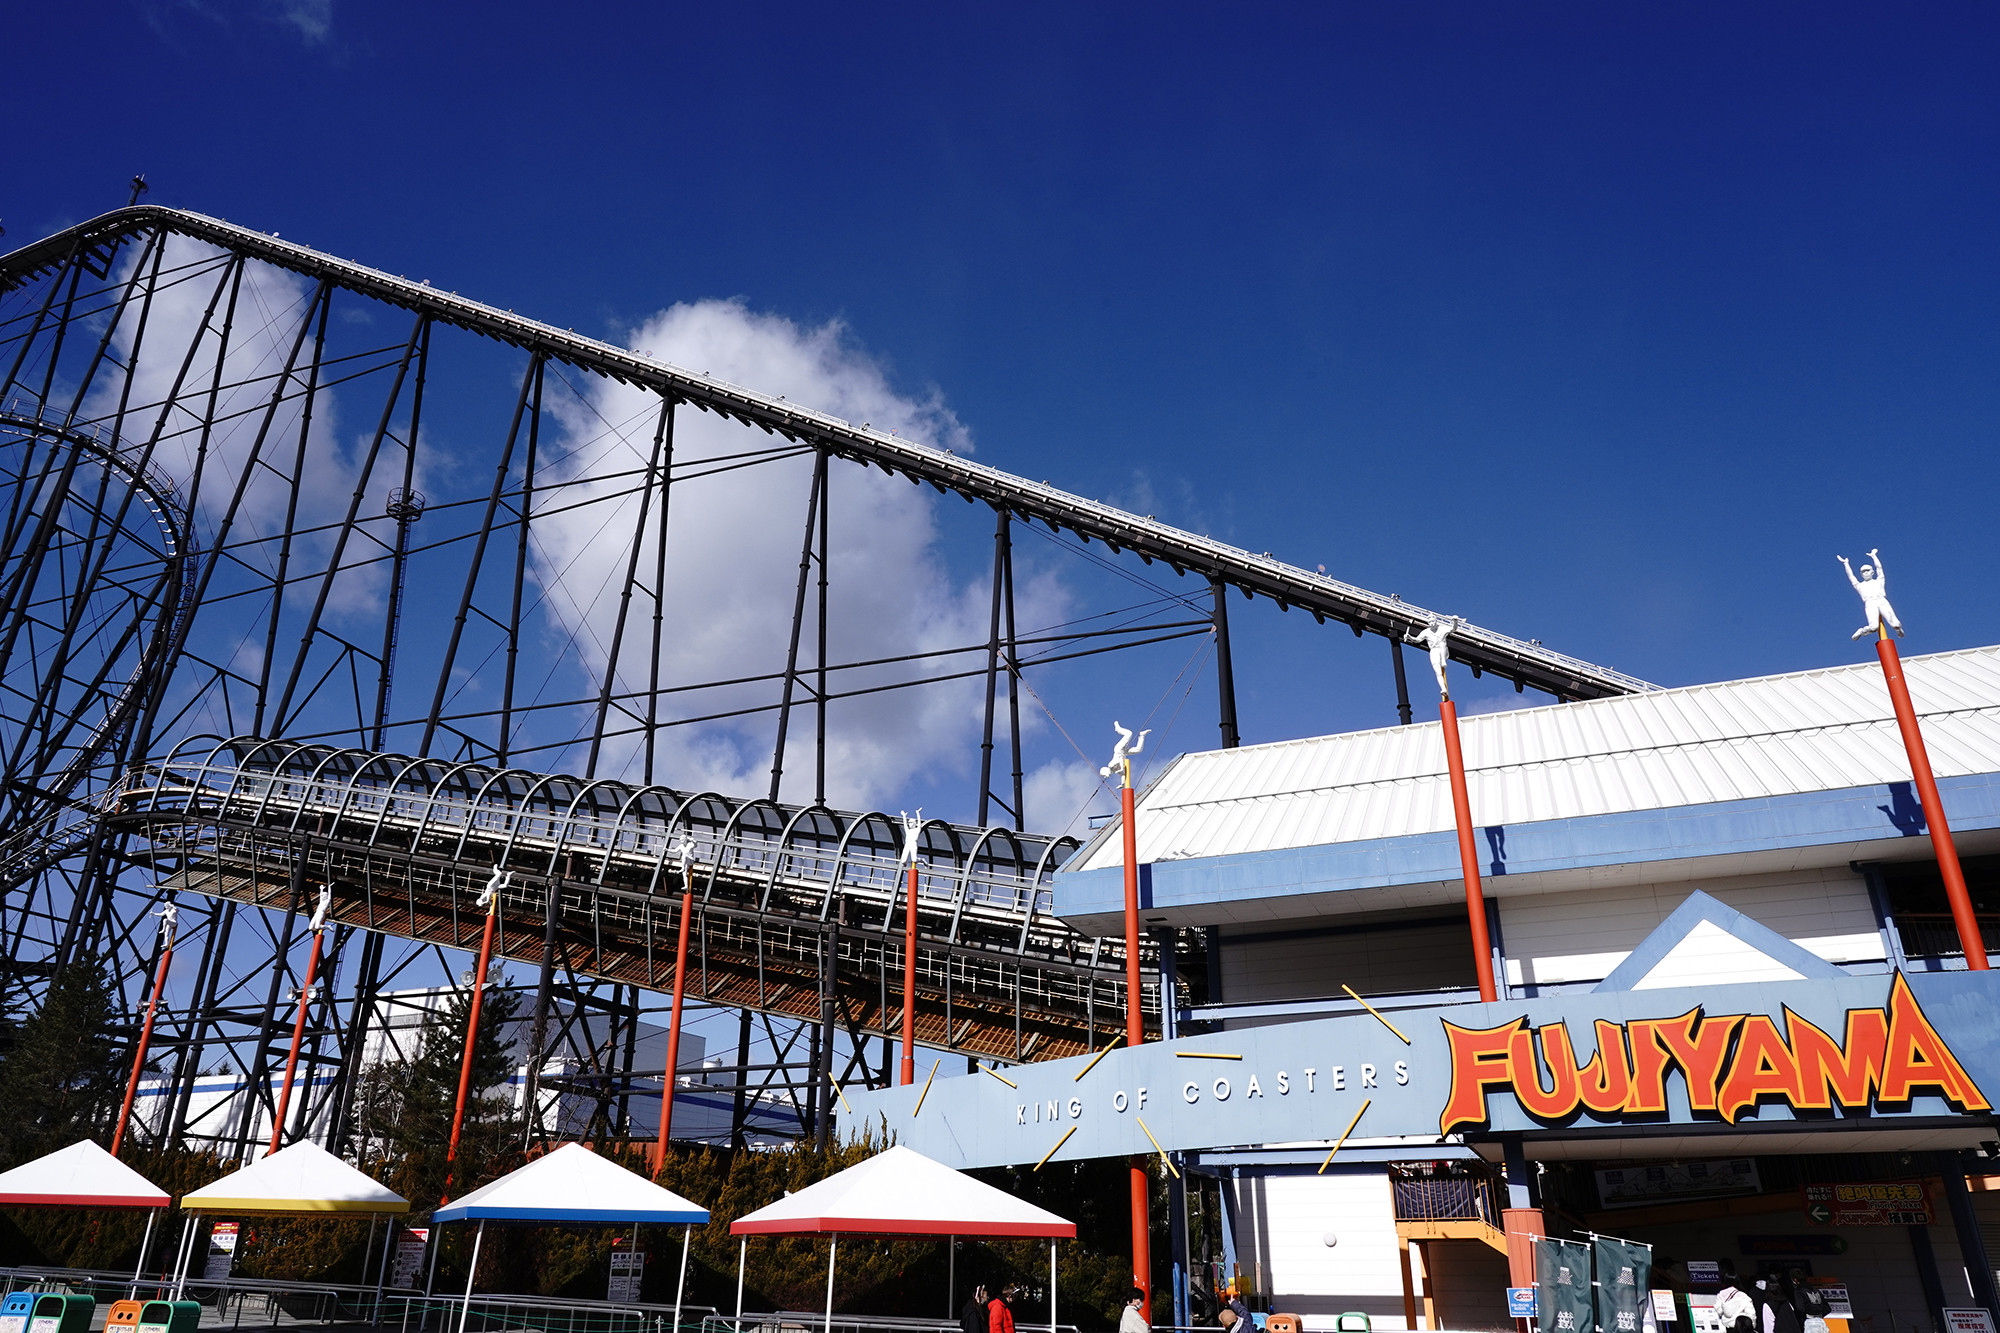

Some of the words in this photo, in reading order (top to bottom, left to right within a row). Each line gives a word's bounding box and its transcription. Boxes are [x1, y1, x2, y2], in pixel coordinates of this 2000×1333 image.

[1440, 968, 1992, 1138] FUJIYAMA
[1016, 1096, 1083, 1126] KING
[1112, 1086, 1149, 1113] OF
[1182, 1059, 1411, 1105] COASTERS
[1837, 1185, 1922, 1201] 絶叫優先券
[1869, 1202, 1898, 1210] Priority
[1899, 1201, 1922, 1209] Ticket
[1690, 1272, 1720, 1280] Tickets
